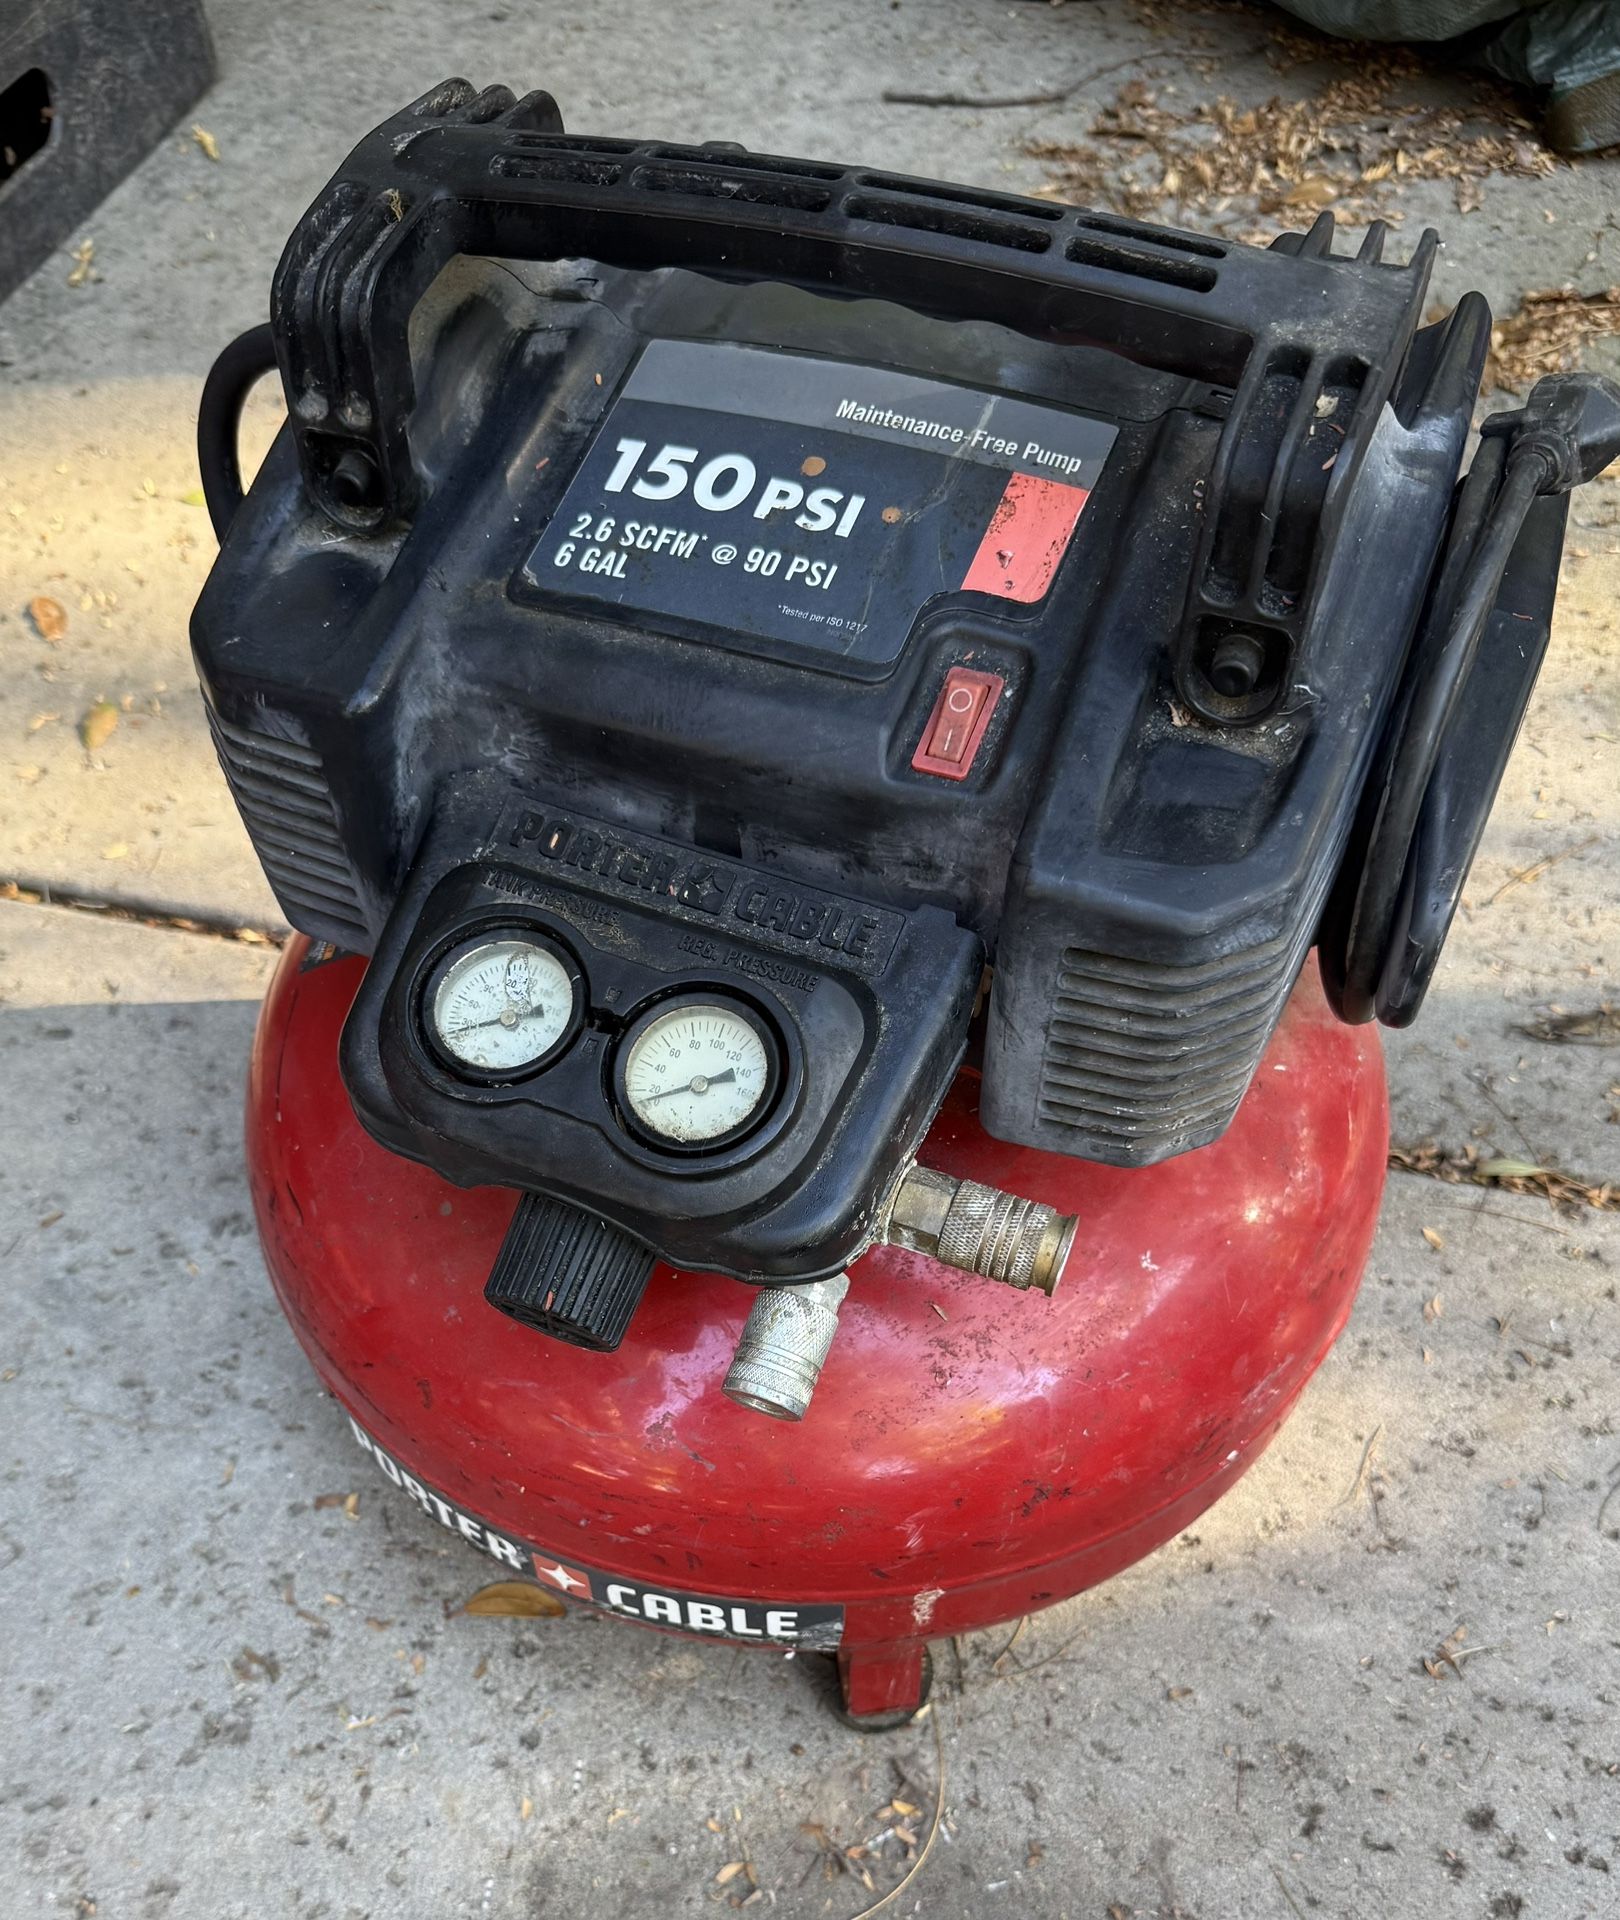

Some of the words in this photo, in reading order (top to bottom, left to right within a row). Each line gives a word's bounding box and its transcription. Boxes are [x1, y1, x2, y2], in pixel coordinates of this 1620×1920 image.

[835, 399, 1018, 458] Maintenance-Free
[1022, 441, 1082, 474] Pump
[603, 438, 757, 512] 150
[753, 478, 866, 538] PSI
[553, 543, 575, 568] 6
[579, 548, 627, 579] GAL
[569, 514, 612, 543] 2.6
[711, 544, 738, 565] @
[743, 547, 777, 577] 90
[784, 554, 838, 590] PSI
[809, 613, 825, 623] per
[826, 616, 844, 627] ISO
[845, 620, 868, 633] 1217
[481, 869, 527, 897] TANK
[530, 885, 620, 926] PRESSURE
[509, 811, 679, 895] PORTER
[735, 883, 878, 958] CABLE
[678, 935, 717, 961] REG.
[722, 950, 820, 993] PRESSURE
[669, 1047, 681, 1059] 60
[689, 1039, 701, 1050] 80
[709, 1038, 726, 1051] 100
[725, 1050, 742, 1062] 120
[654, 1063, 667, 1074] 40
[735, 1066, 752, 1078] 140
[648, 1083, 661, 1094] 20
[349, 1416, 522, 1569] PORTER
[607, 1583, 799, 1637] CABLE
